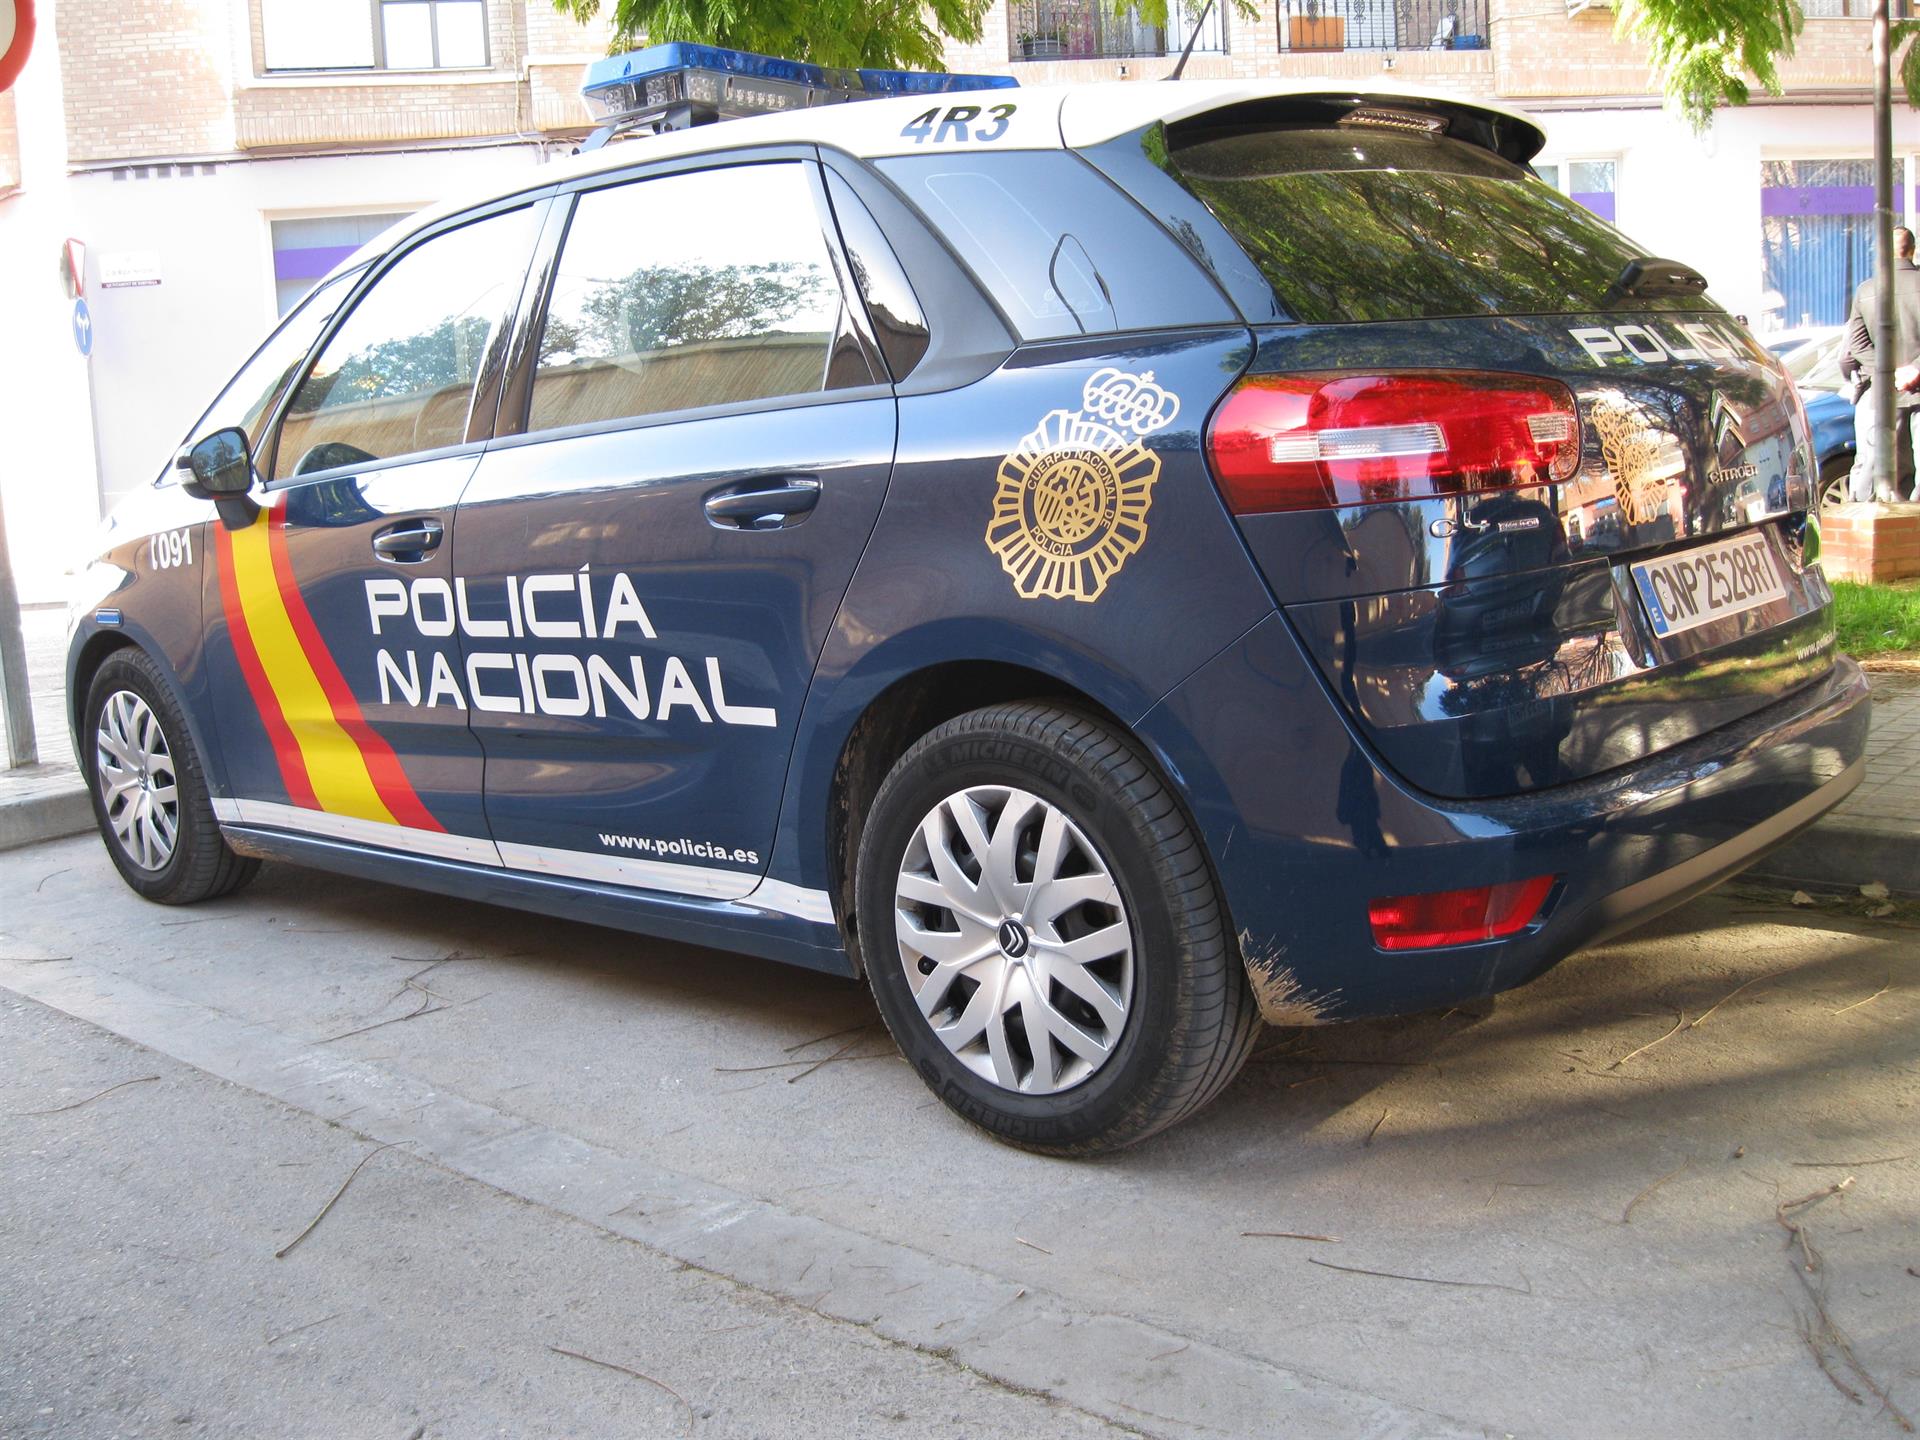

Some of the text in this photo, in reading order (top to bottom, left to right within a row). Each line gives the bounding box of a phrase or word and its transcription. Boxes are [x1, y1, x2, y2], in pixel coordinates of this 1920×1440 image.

[900, 103, 1018, 144] 4R3
[1027, 448, 1117, 530] CUERPO NACIONAL DE
[1030, 525, 1074, 557] POLICIA
[1430, 511, 1491, 538] C4
[364, 562, 658, 639] POLICÍA
[1650, 607, 1662, 623] E
[376, 648, 778, 728] NACIONAL
[951, 741, 1071, 790] MICHELIN
[598, 833, 759, 865] www.policia.es
